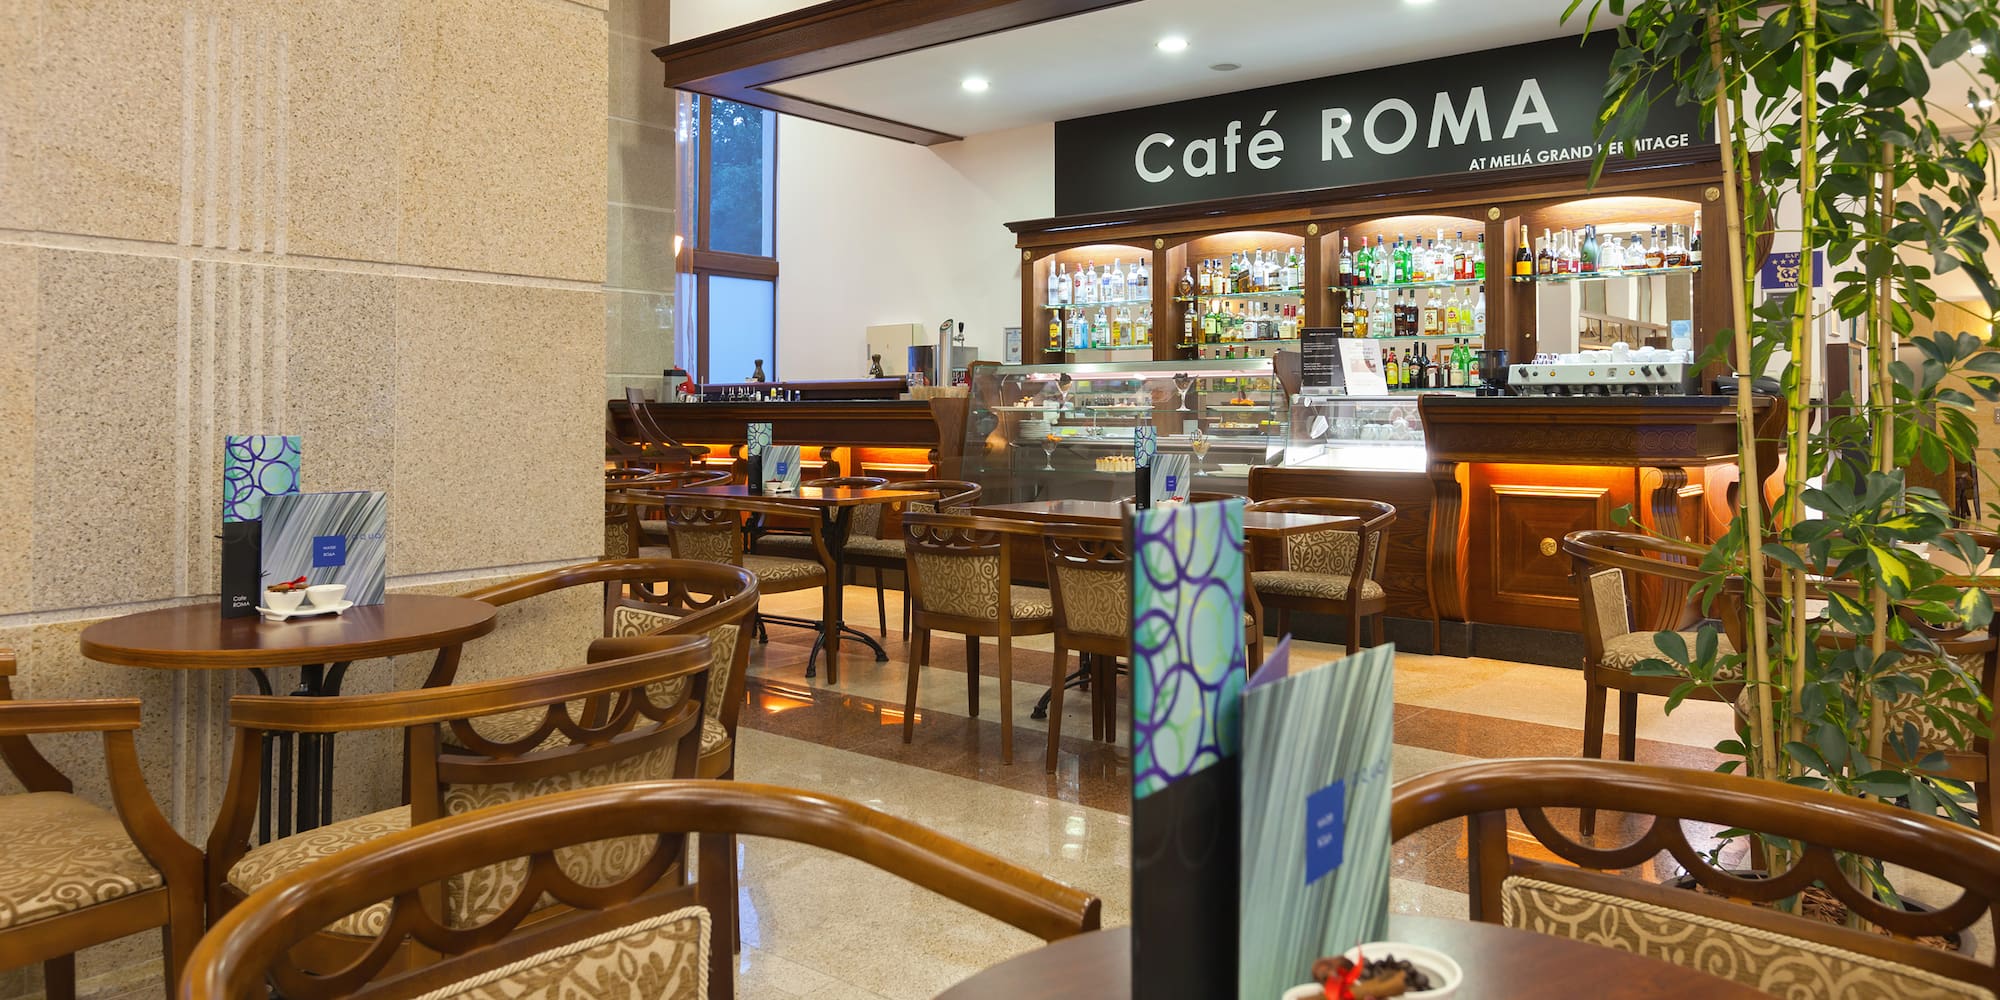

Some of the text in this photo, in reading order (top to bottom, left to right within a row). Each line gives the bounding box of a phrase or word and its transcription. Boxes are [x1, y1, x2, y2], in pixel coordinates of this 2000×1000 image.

[1134, 77, 1559, 184] Café ROMA
[1469, 158, 1487, 171] AT
[1490, 149, 1533, 169] MELIÁ
[1537, 145, 1593, 163] GRAND
